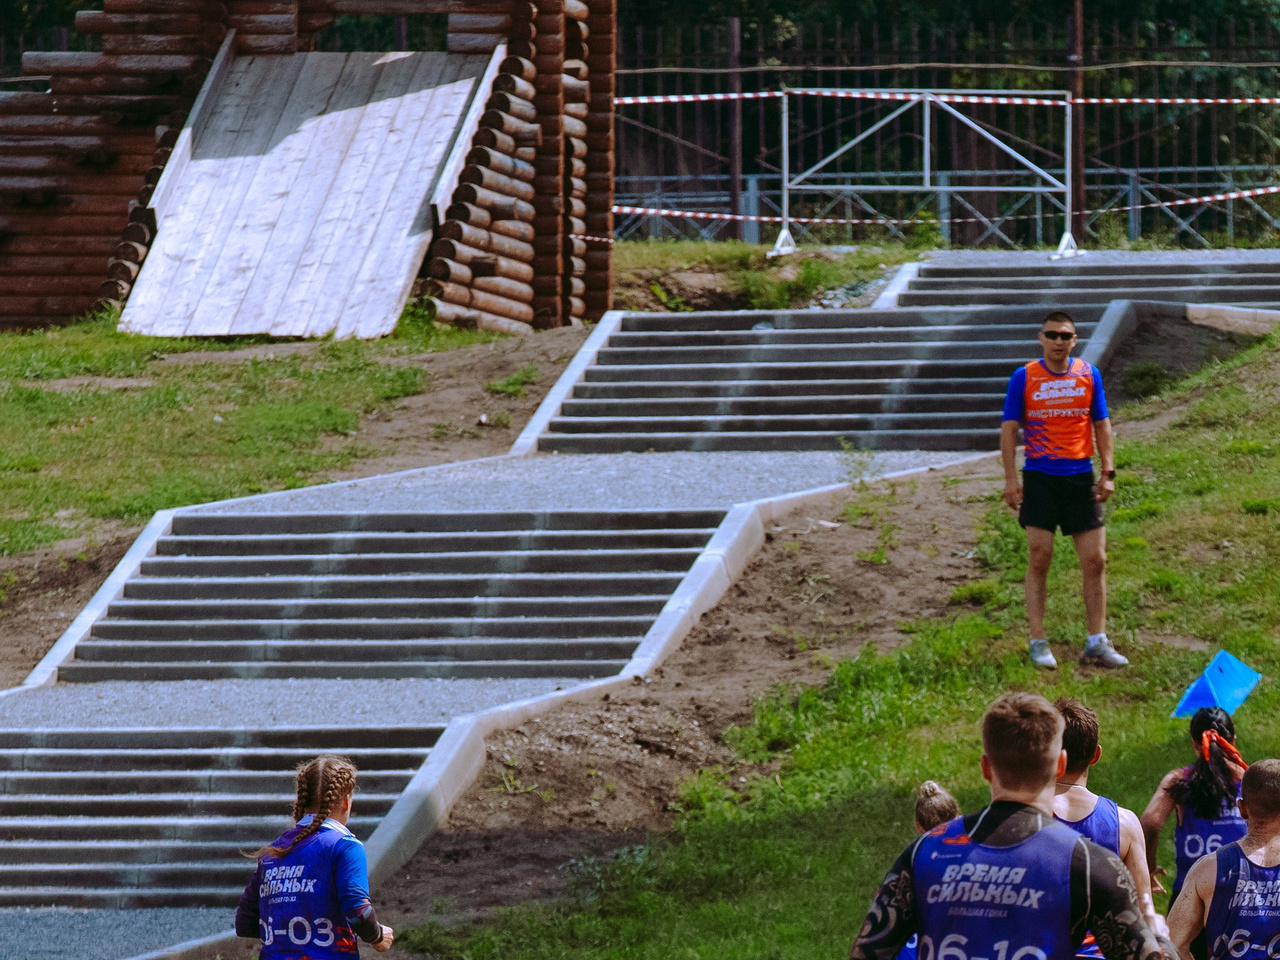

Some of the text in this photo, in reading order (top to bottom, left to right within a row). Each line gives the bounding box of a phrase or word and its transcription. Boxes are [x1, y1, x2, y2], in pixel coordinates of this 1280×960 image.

[264, 865, 305, 882] ВРЕМЯ
[942, 863, 1027, 884] ВРЕМЯ
[259, 878, 317, 898] СИЛЬНЫХ
[926, 881, 1045, 909] СИЛЬНЫХ
